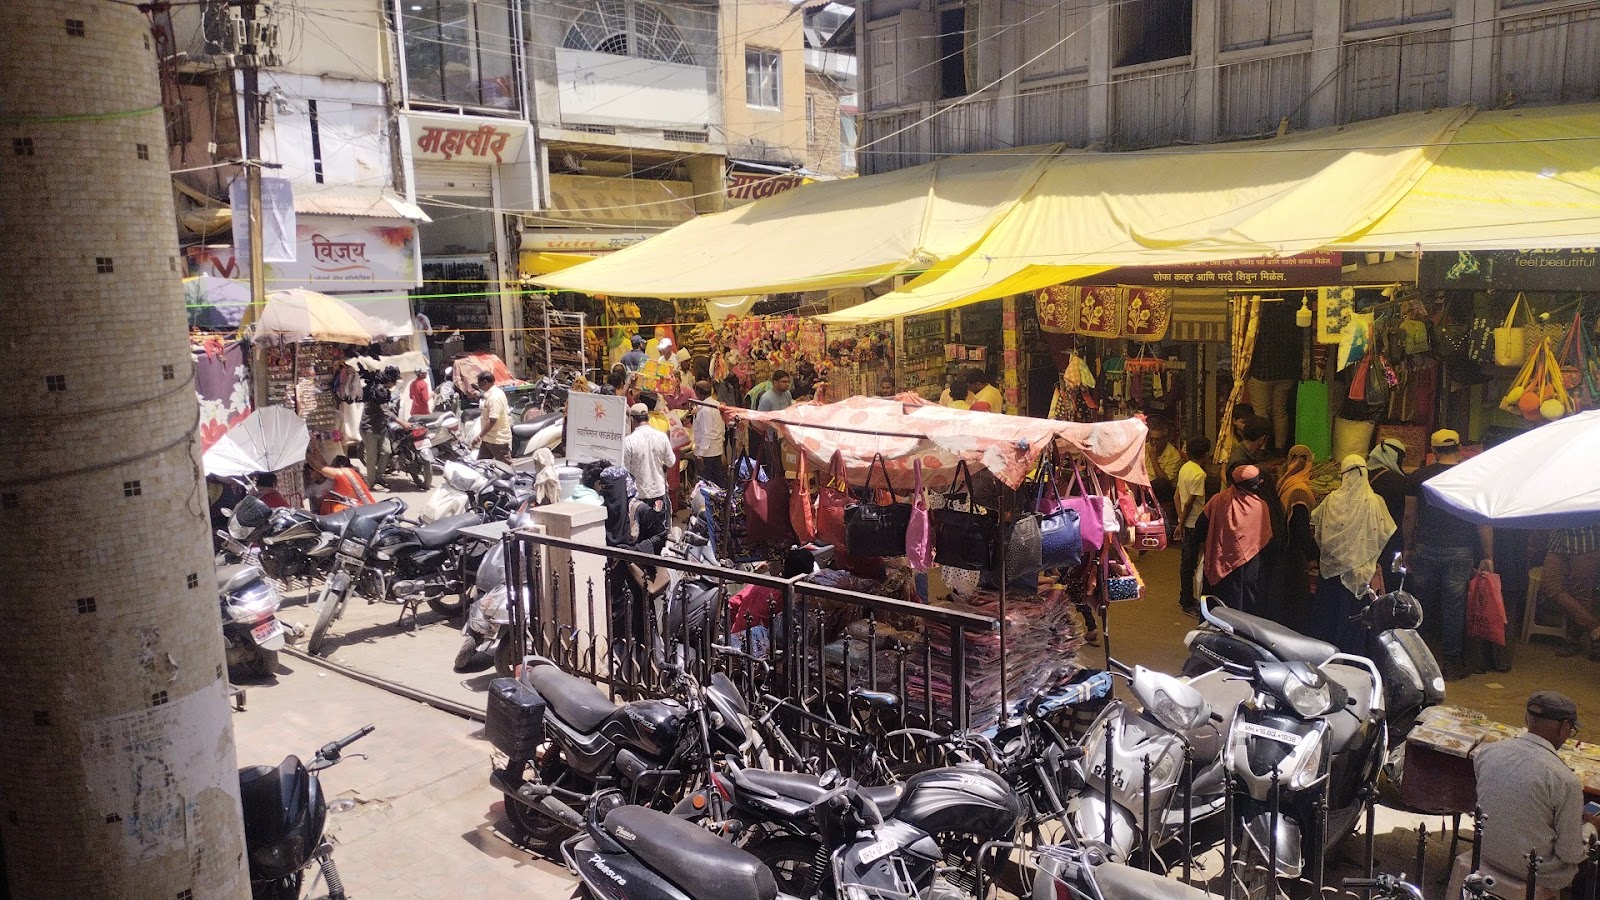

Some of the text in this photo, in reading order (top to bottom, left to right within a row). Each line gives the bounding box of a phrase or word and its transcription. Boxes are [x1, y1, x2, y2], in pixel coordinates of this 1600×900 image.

[417, 124, 511, 164] महावीर
[312, 234, 371, 263] विजय
[1540, 256, 1596, 267] beautiful
[1153, 271, 1172, 281] सोफा
[1174, 273, 1194, 283] कव्हर
[1196, 271, 1216, 281] आणि
[1217, 271, 1234, 282] परदे
[1260, 270, 1287, 281] मिळेल.
[587, 853, 627, 886] Pleasure
